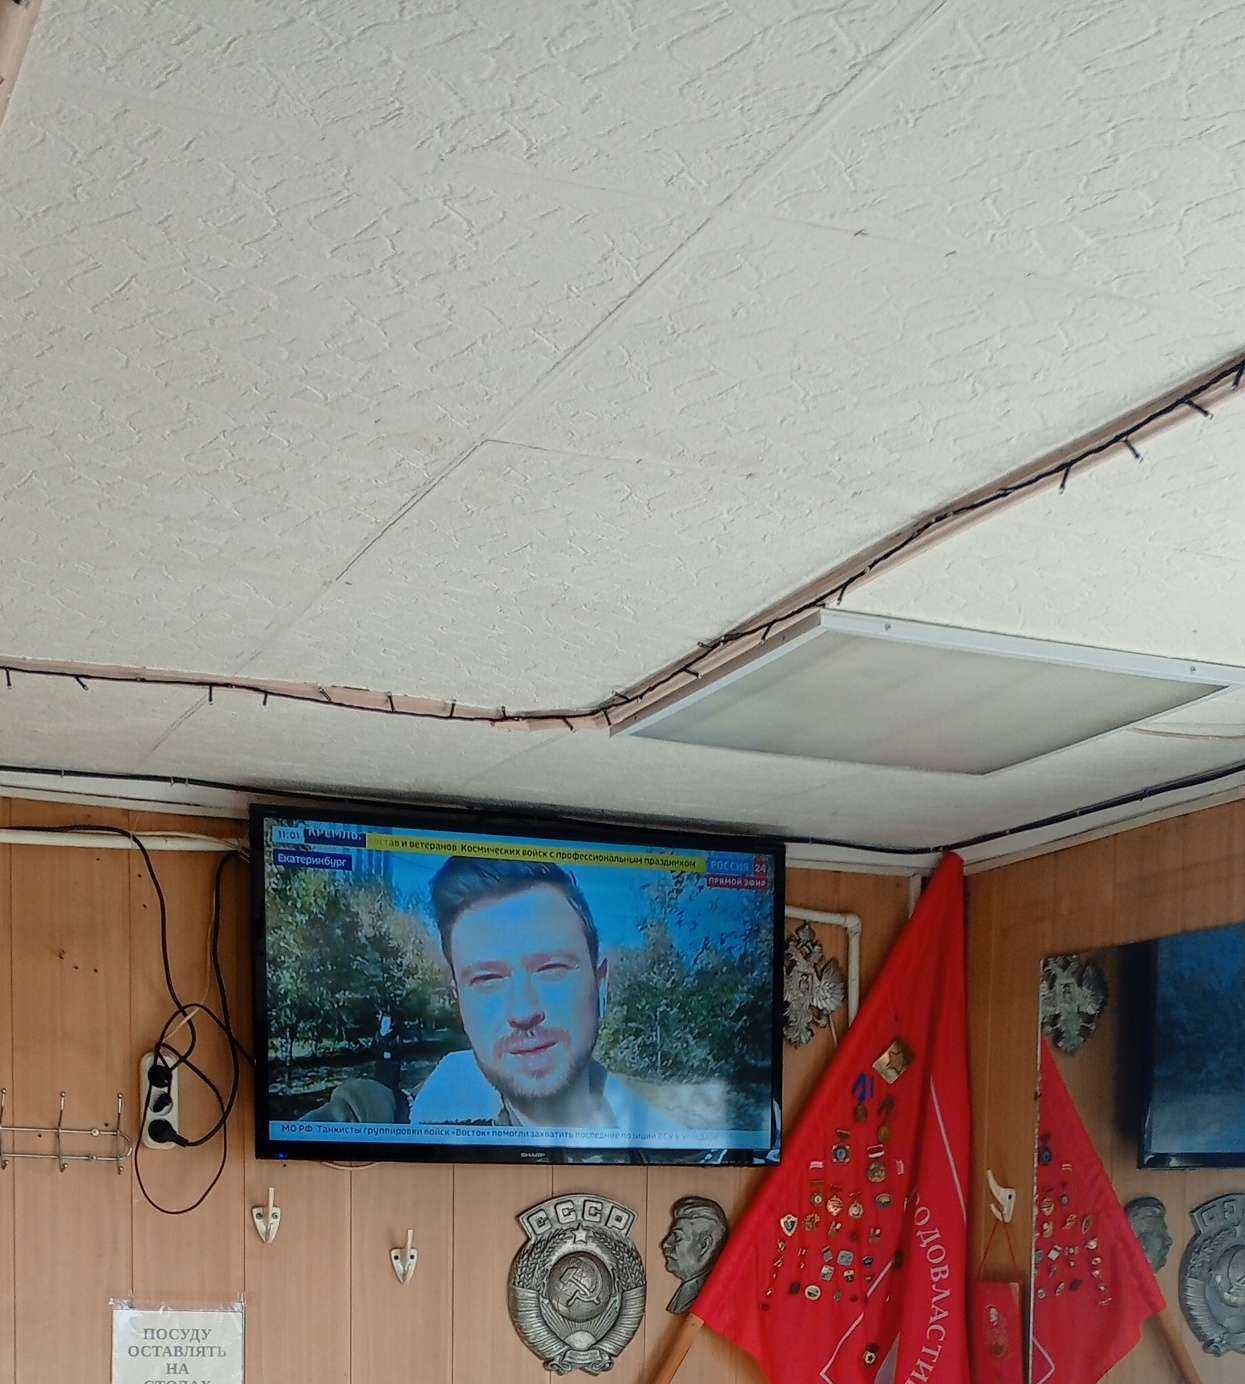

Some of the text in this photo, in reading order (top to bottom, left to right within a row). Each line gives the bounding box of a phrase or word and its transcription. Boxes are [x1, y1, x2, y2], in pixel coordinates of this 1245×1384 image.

[278, 853, 346, 868] Екатеринбург
[461, 844, 520, 857] Космических
[522, 849, 547, 858] войск
[556, 851, 643, 864] профессиональным
[644, 858, 696, 869] праздником
[282, 1125, 297, 1133] МО
[299, 1125, 313, 1133] РФ
[317, 1125, 362, 1134] Танкисты
[363, 1126, 422, 1136] группировки
[492, 1130, 529, 1138] помогли
[527, 1199, 631, 1235] СССР
[143, 1328, 212, 1342] ПОСУДУ
[127, 1345, 227, 1358] ОСТАВЛЯТЬ
[165, 1362, 190, 1375] НА
